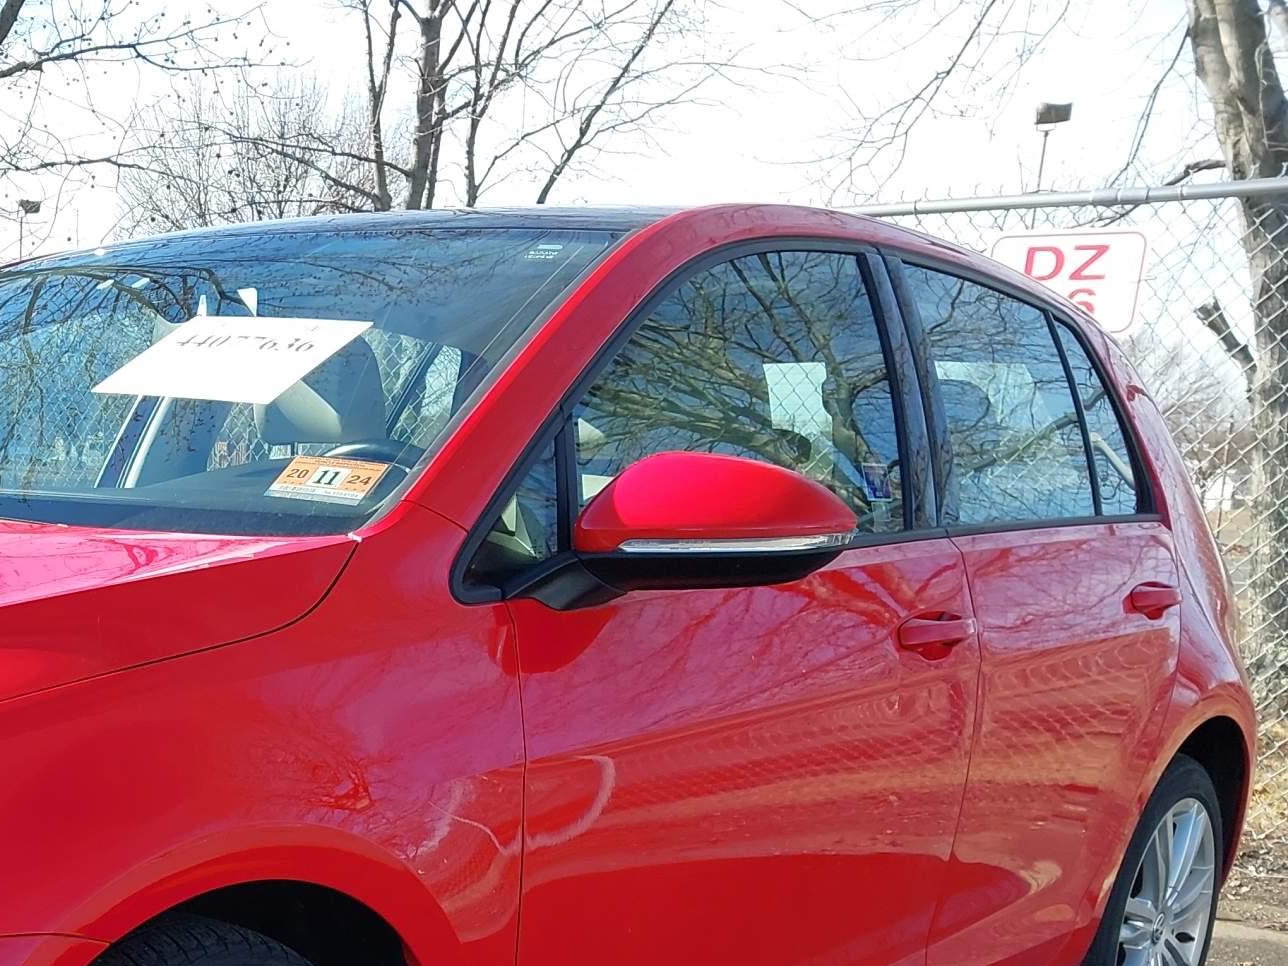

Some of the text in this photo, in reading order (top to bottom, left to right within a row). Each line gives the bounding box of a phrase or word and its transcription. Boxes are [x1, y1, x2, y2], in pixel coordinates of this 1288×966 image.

[1024, 245, 1111, 281] DZ
[286, 468, 372, 486] 20 11 24
